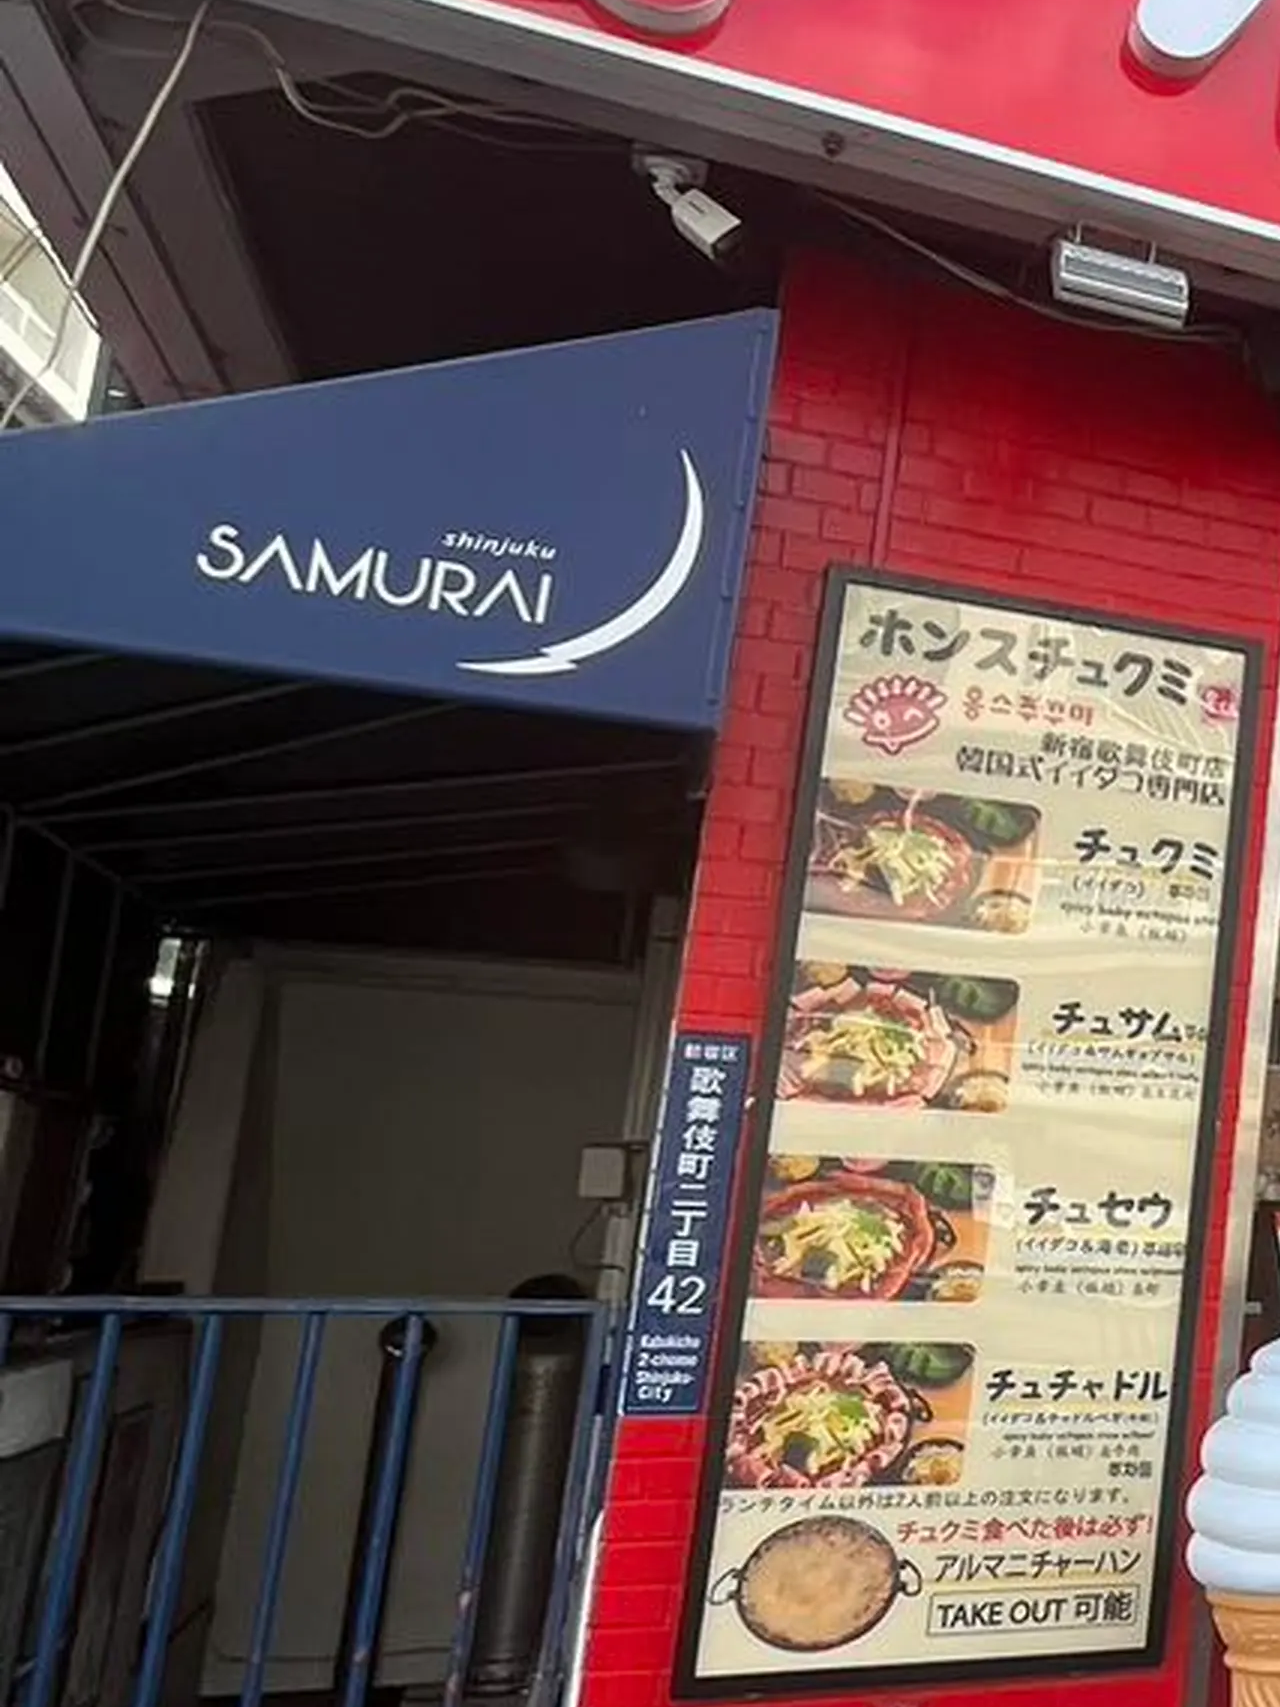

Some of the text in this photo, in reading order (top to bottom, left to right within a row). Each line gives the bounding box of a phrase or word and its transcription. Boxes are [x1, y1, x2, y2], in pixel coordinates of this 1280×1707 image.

[442, 529, 557, 561] shinjuku
[196, 523, 555, 624] SAMURAI
[859, 608, 1194, 706] ホンスチュクミ
[955, 744, 1226, 807] 韓国式イイダコ専門店
[1040, 731, 1228, 779] 新宿歌舞伎町店
[1074, 827, 1219, 881] チュクミ
[1052, 1000, 1183, 1043] チュサム
[666, 1065, 727, 1268] 歌舞伎町二丁目
[1023, 1186, 1173, 1230] チュセウ
[646, 1274, 707, 1314] 42
[637, 1382, 673, 1403] City
[985, 1368, 1169, 1402] チュチャドル
[934, 1549, 1142, 1583] アルマニチャーハン
[936, 1592, 1133, 1630] TAKE OUT 可能
